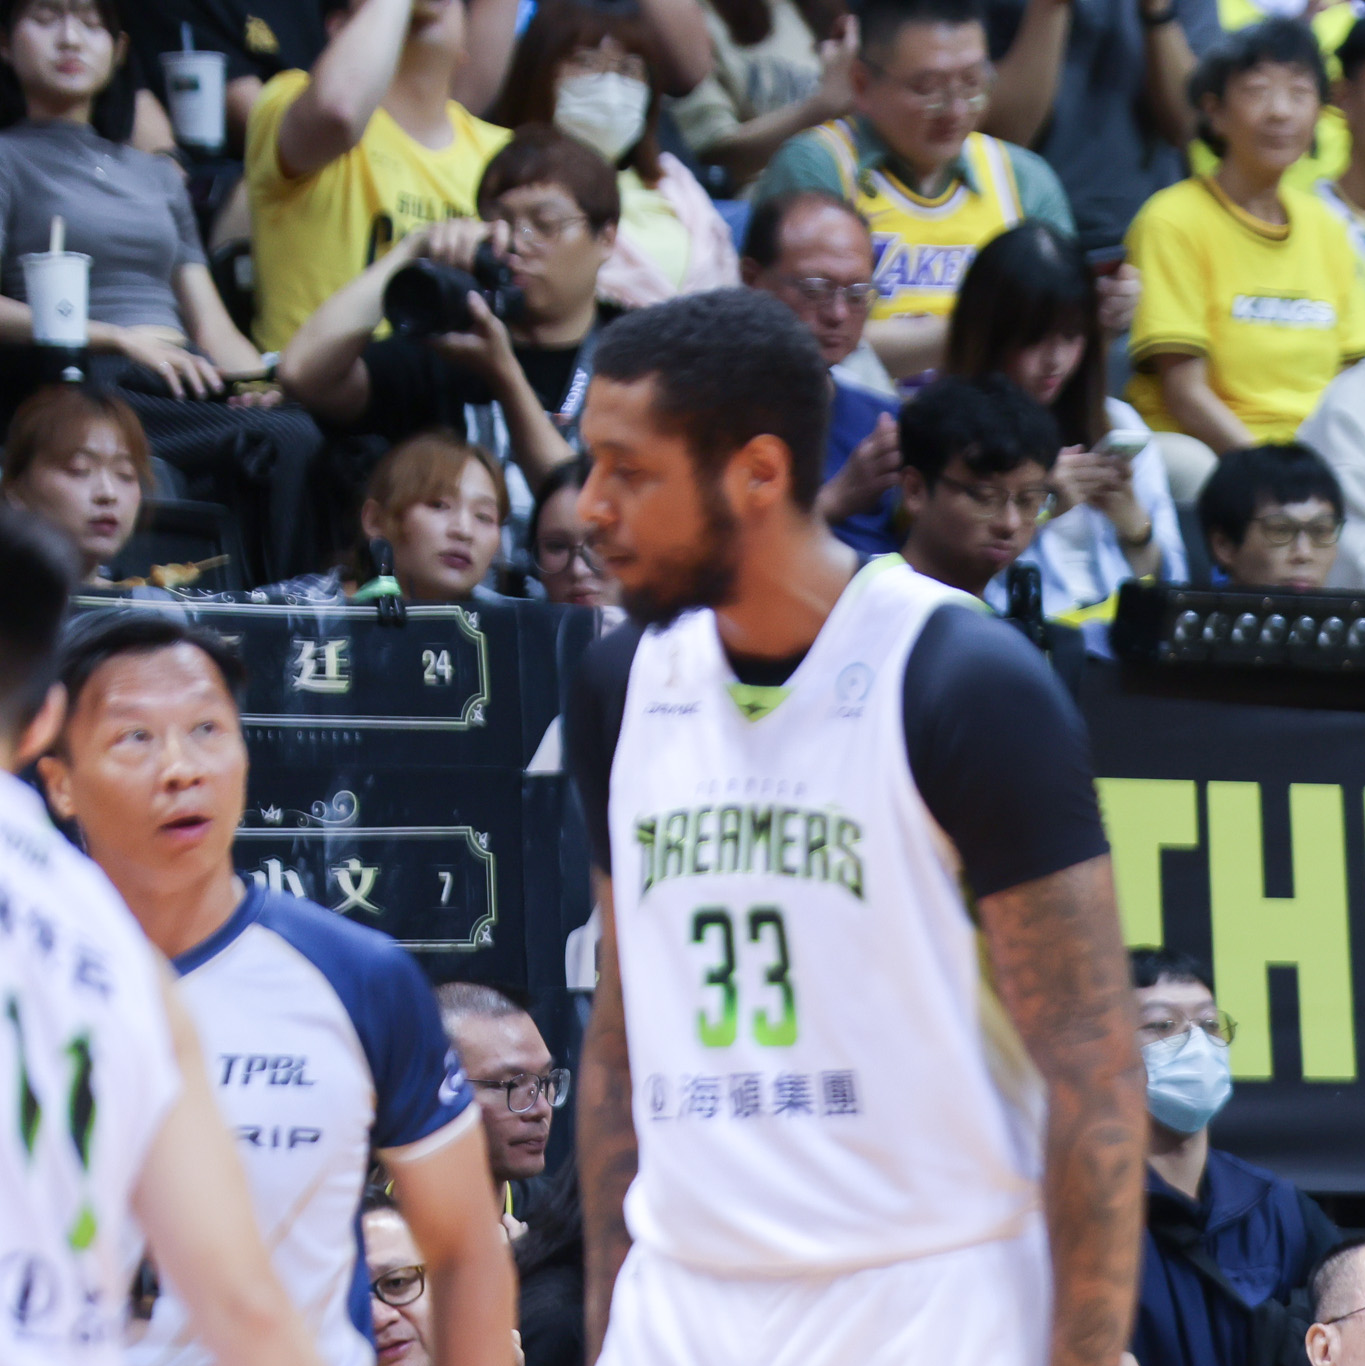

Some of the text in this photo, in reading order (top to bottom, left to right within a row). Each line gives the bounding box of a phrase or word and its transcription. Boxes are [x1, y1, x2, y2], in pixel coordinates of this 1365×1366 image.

[871, 231, 976, 298] LAKE
[421, 648, 454, 685] 24
[437, 871, 452, 906] 7
[689, 906, 798, 1047] 33
[219, 1053, 317, 1087] TPBL
[236, 1124, 323, 1149] RIP
